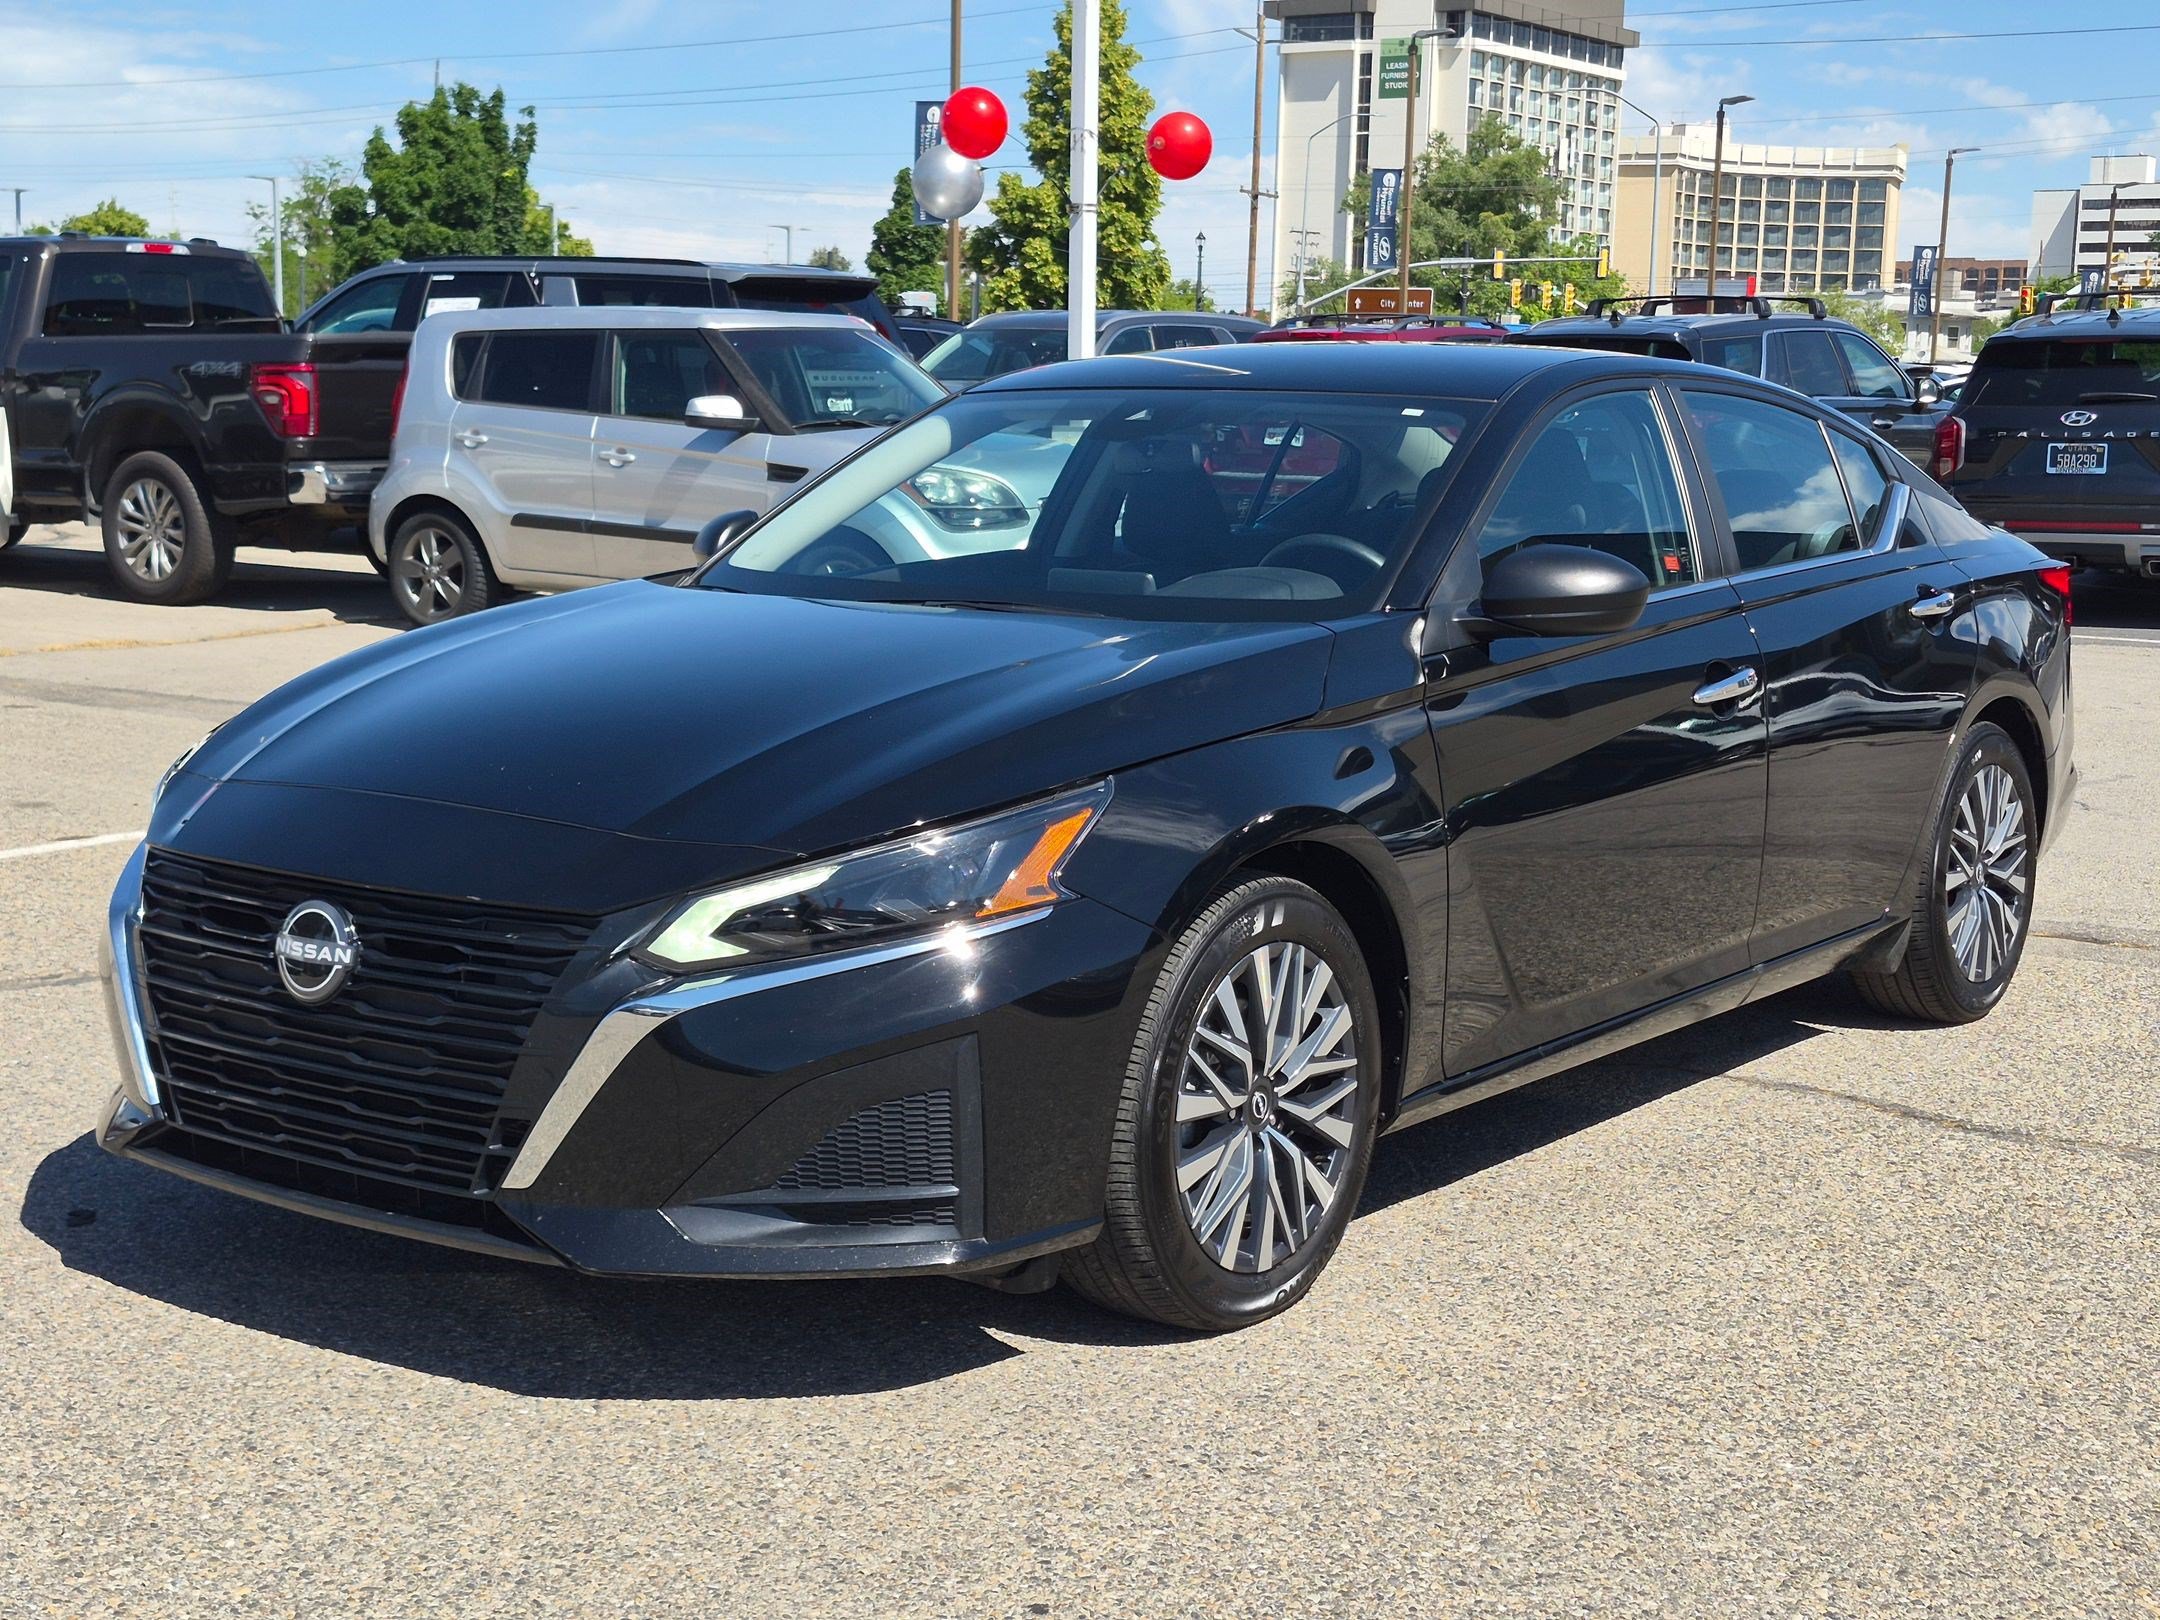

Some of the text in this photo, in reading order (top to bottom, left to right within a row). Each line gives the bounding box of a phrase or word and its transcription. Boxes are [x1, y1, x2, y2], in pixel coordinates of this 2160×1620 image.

[1385, 62, 1409, 70] LEASIN
[1384, 81, 1409, 89] STUDIO
[1380, 299, 1424, 309] City nter
[1997, 430, 2160, 438] PALISADE
[2057, 454, 2097, 468] 5BA298
[276, 936, 352, 964] NISSAN
